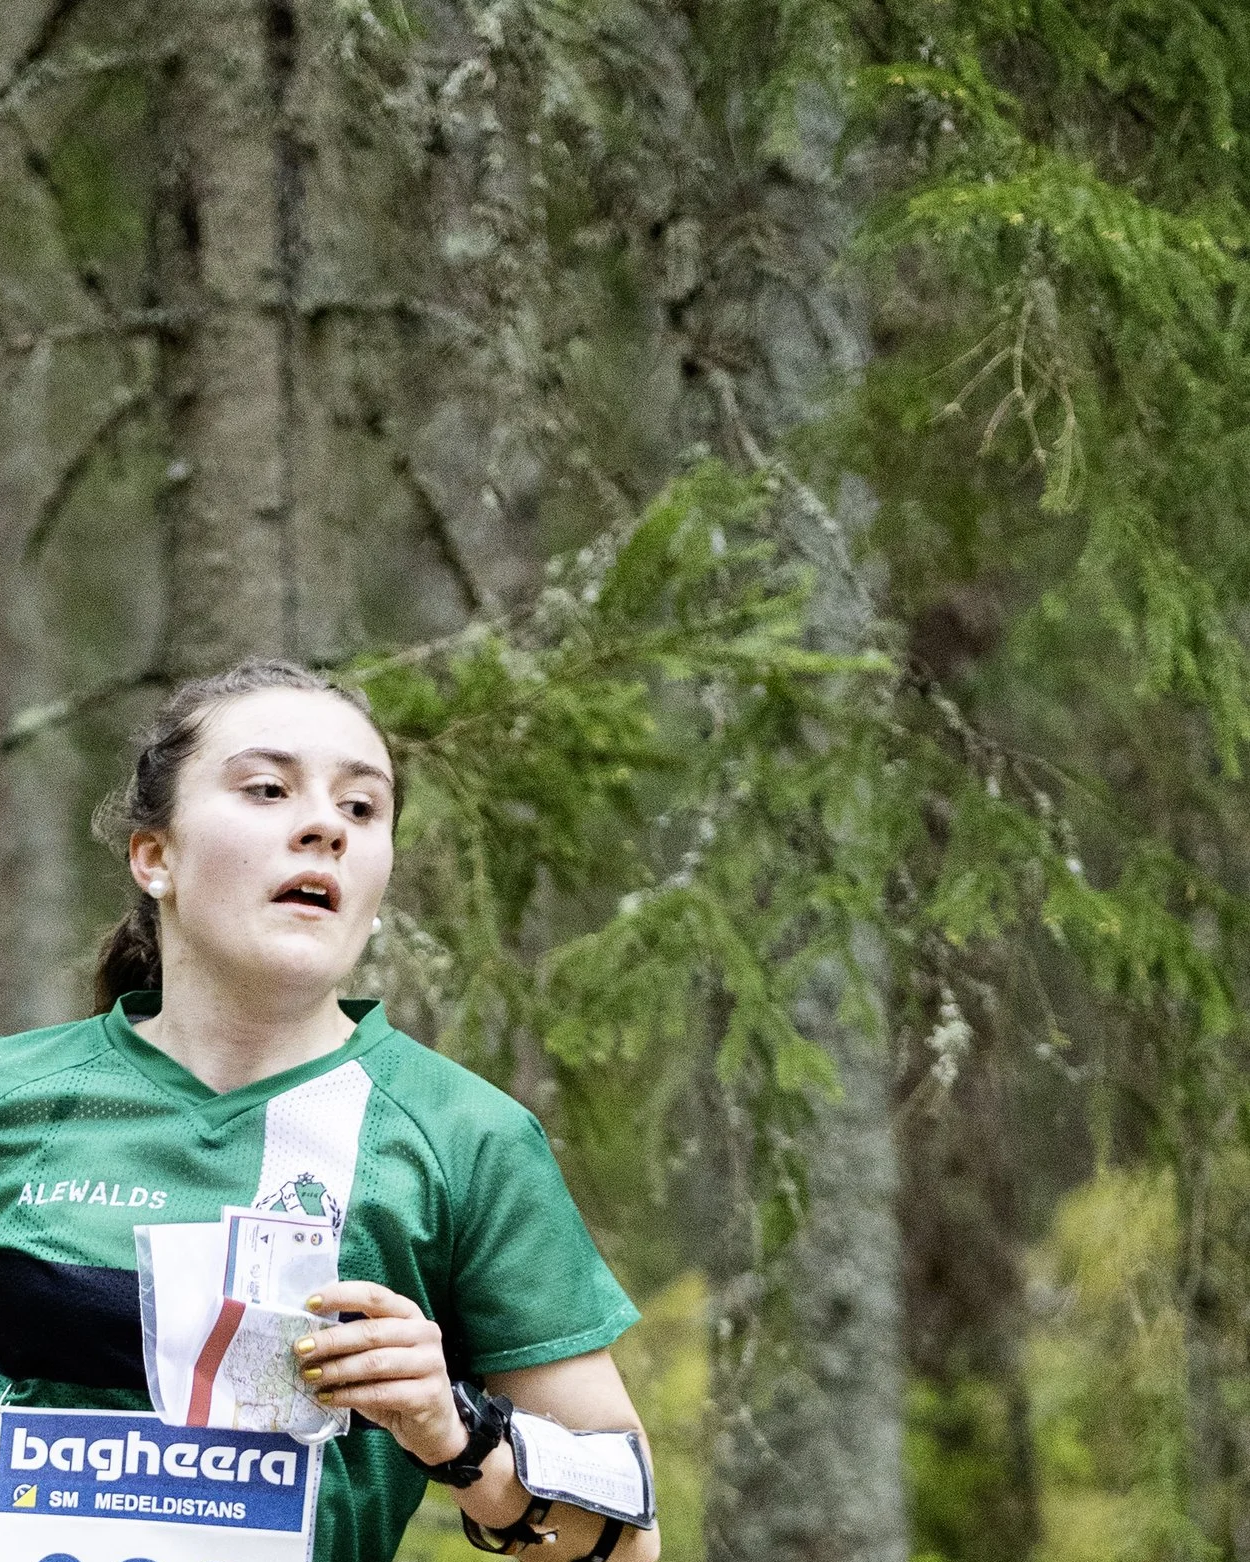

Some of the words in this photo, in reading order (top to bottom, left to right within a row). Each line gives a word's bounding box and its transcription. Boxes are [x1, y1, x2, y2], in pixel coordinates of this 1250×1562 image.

[17, 1179, 168, 1209] ALEWALDS
[10, 1427, 298, 1486] bagheera
[49, 1490, 79, 1509] SM
[94, 1493, 246, 1520] MEDELDISTANS
